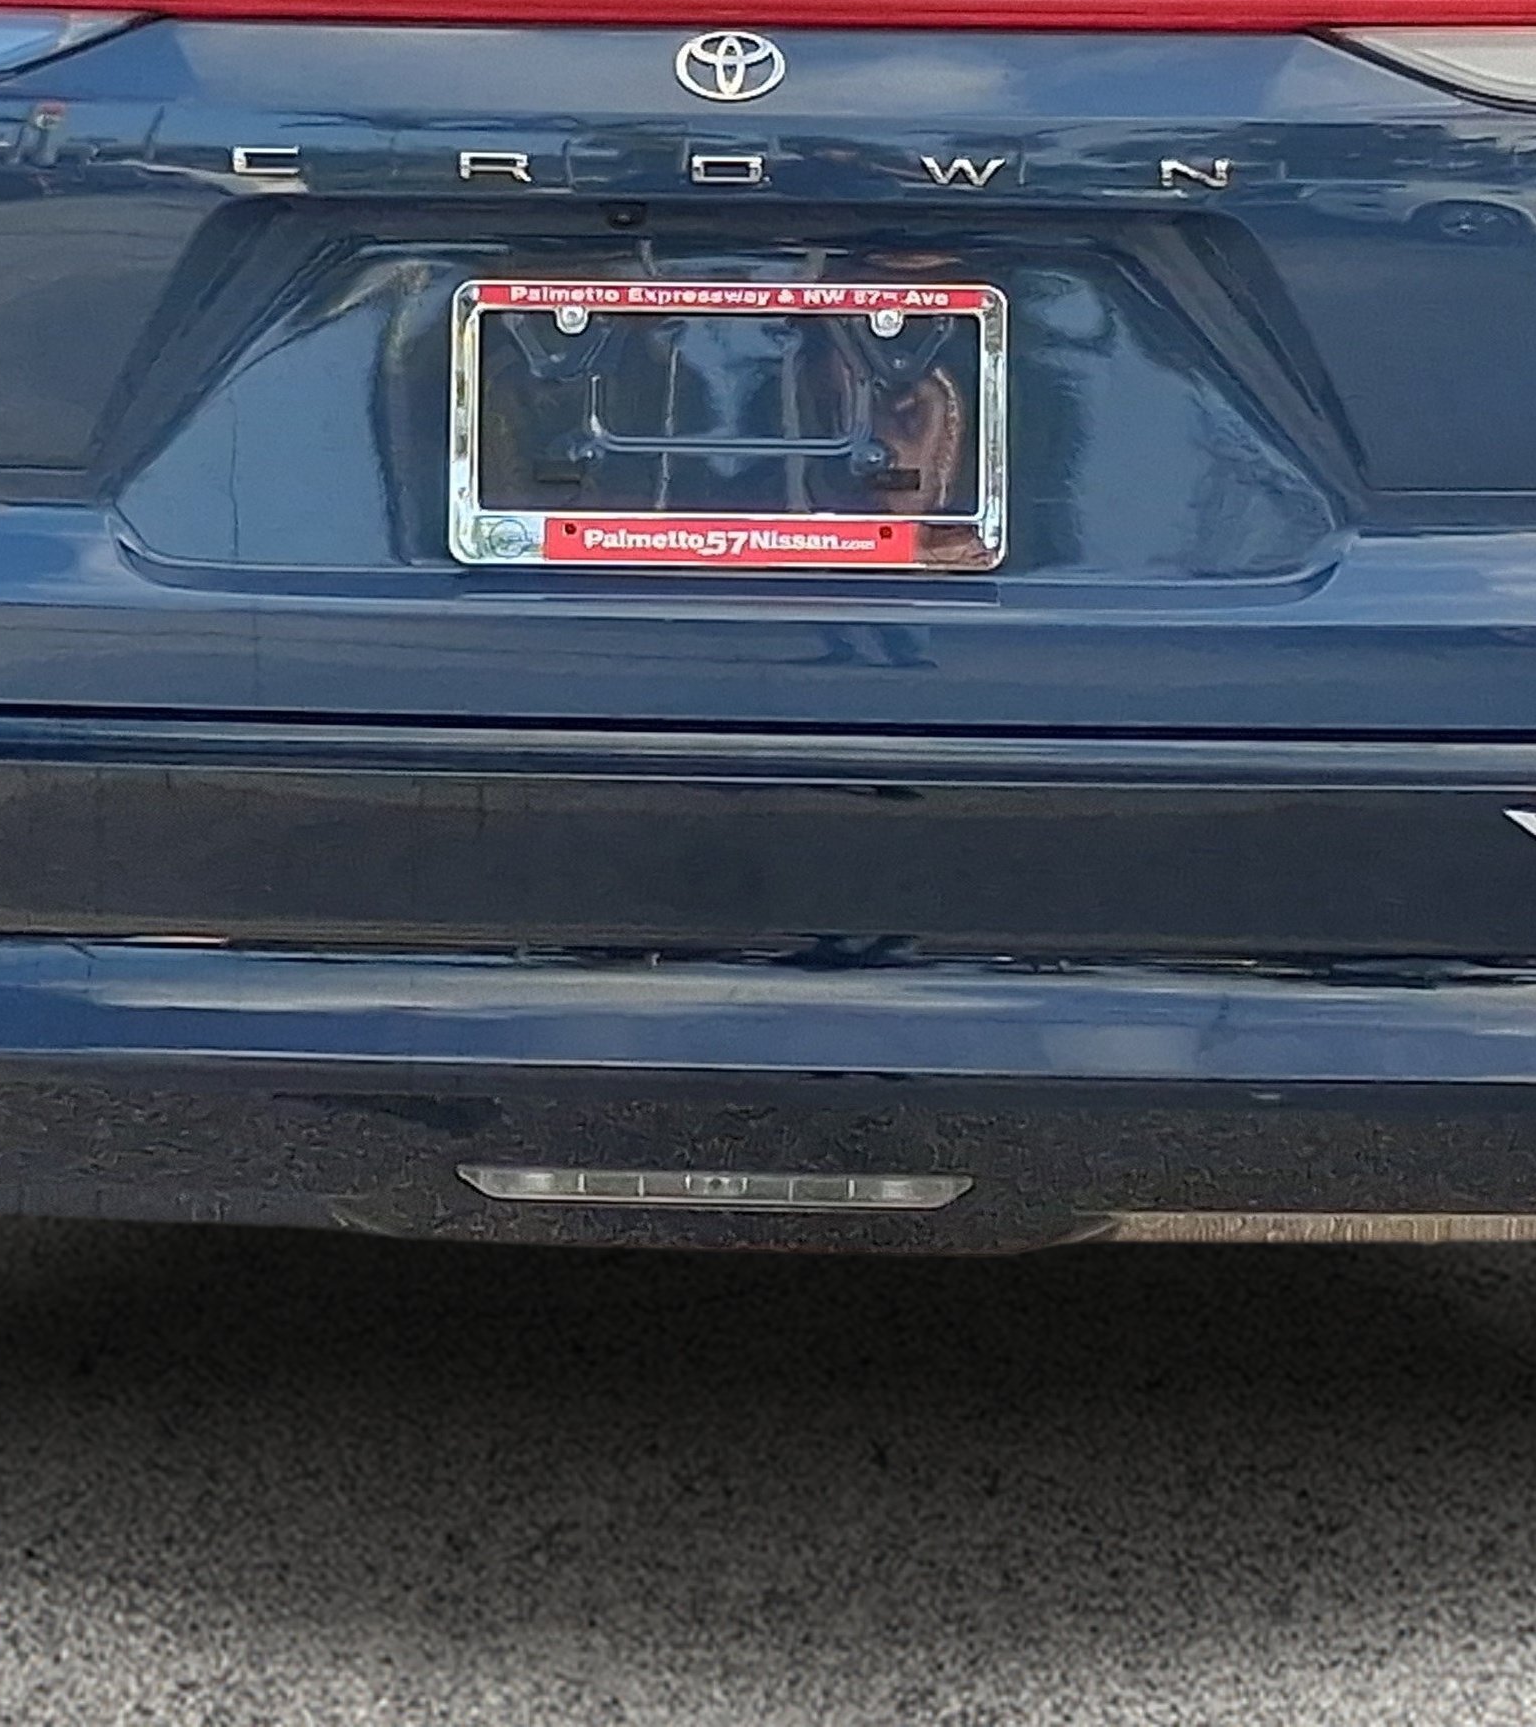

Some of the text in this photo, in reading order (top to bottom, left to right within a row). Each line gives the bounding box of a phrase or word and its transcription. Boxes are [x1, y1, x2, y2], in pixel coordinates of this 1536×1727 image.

[231, 145, 1233, 188] CROWN
[510, 285, 620, 303] Palmetto
[627, 286, 771, 306] Expressway
[777, 288, 796, 304] &
[803, 289, 847, 305] NW
[905, 290, 950, 306] Ave
